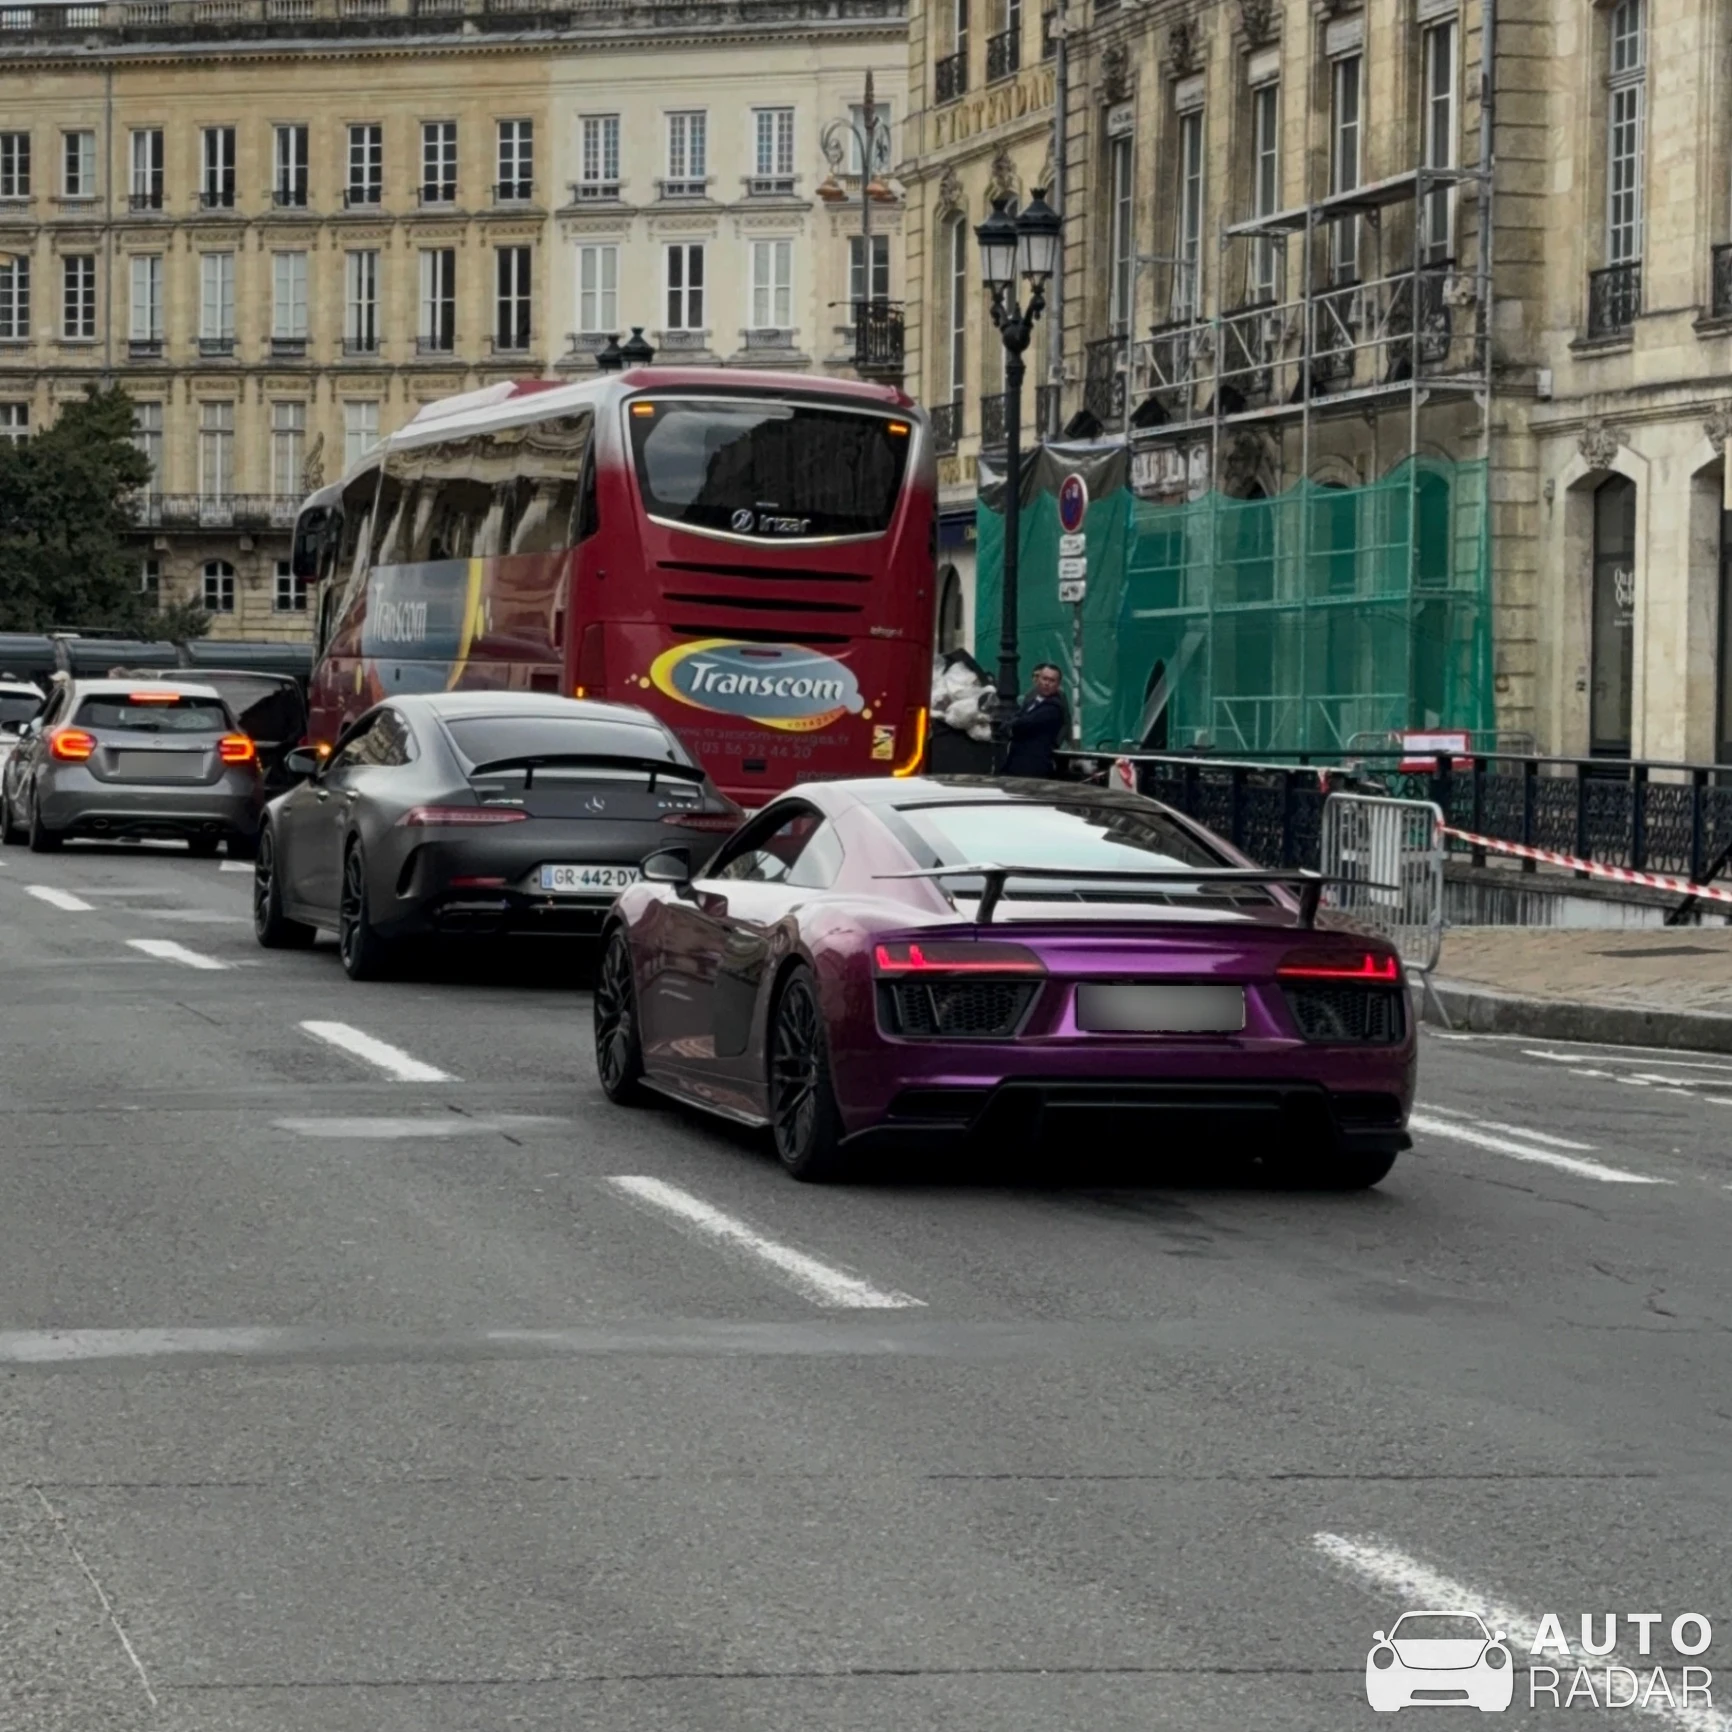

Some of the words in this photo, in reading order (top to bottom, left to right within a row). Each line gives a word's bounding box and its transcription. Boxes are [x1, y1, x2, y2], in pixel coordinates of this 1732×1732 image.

[935, 68, 1056, 150] L'INTENDAN
[373, 583, 427, 642] Transcom
[689, 661, 845, 700] Transcom
[554, 868, 638, 887] GR-442-DY
